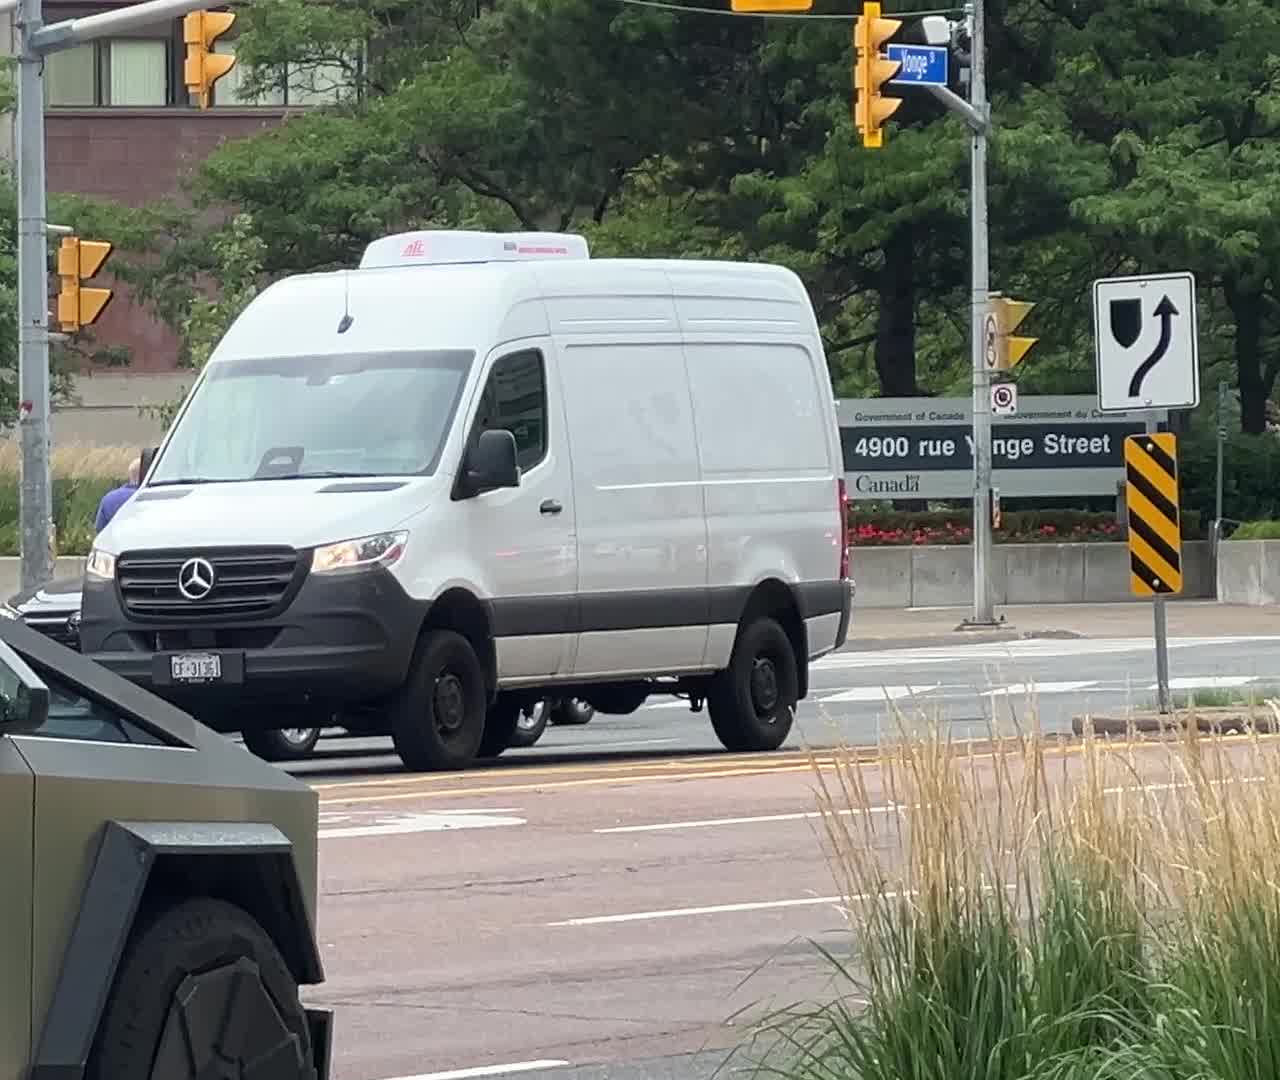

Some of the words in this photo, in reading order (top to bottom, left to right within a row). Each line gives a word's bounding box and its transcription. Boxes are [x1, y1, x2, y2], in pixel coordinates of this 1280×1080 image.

[901, 49, 928, 80] Yonge
[855, 437, 909, 457] 4900
[919, 439, 956, 457] rue
[965, 434, 1034, 459] Ynge
[1044, 434, 1111, 454] Street
[856, 475, 920, 493] Canada
